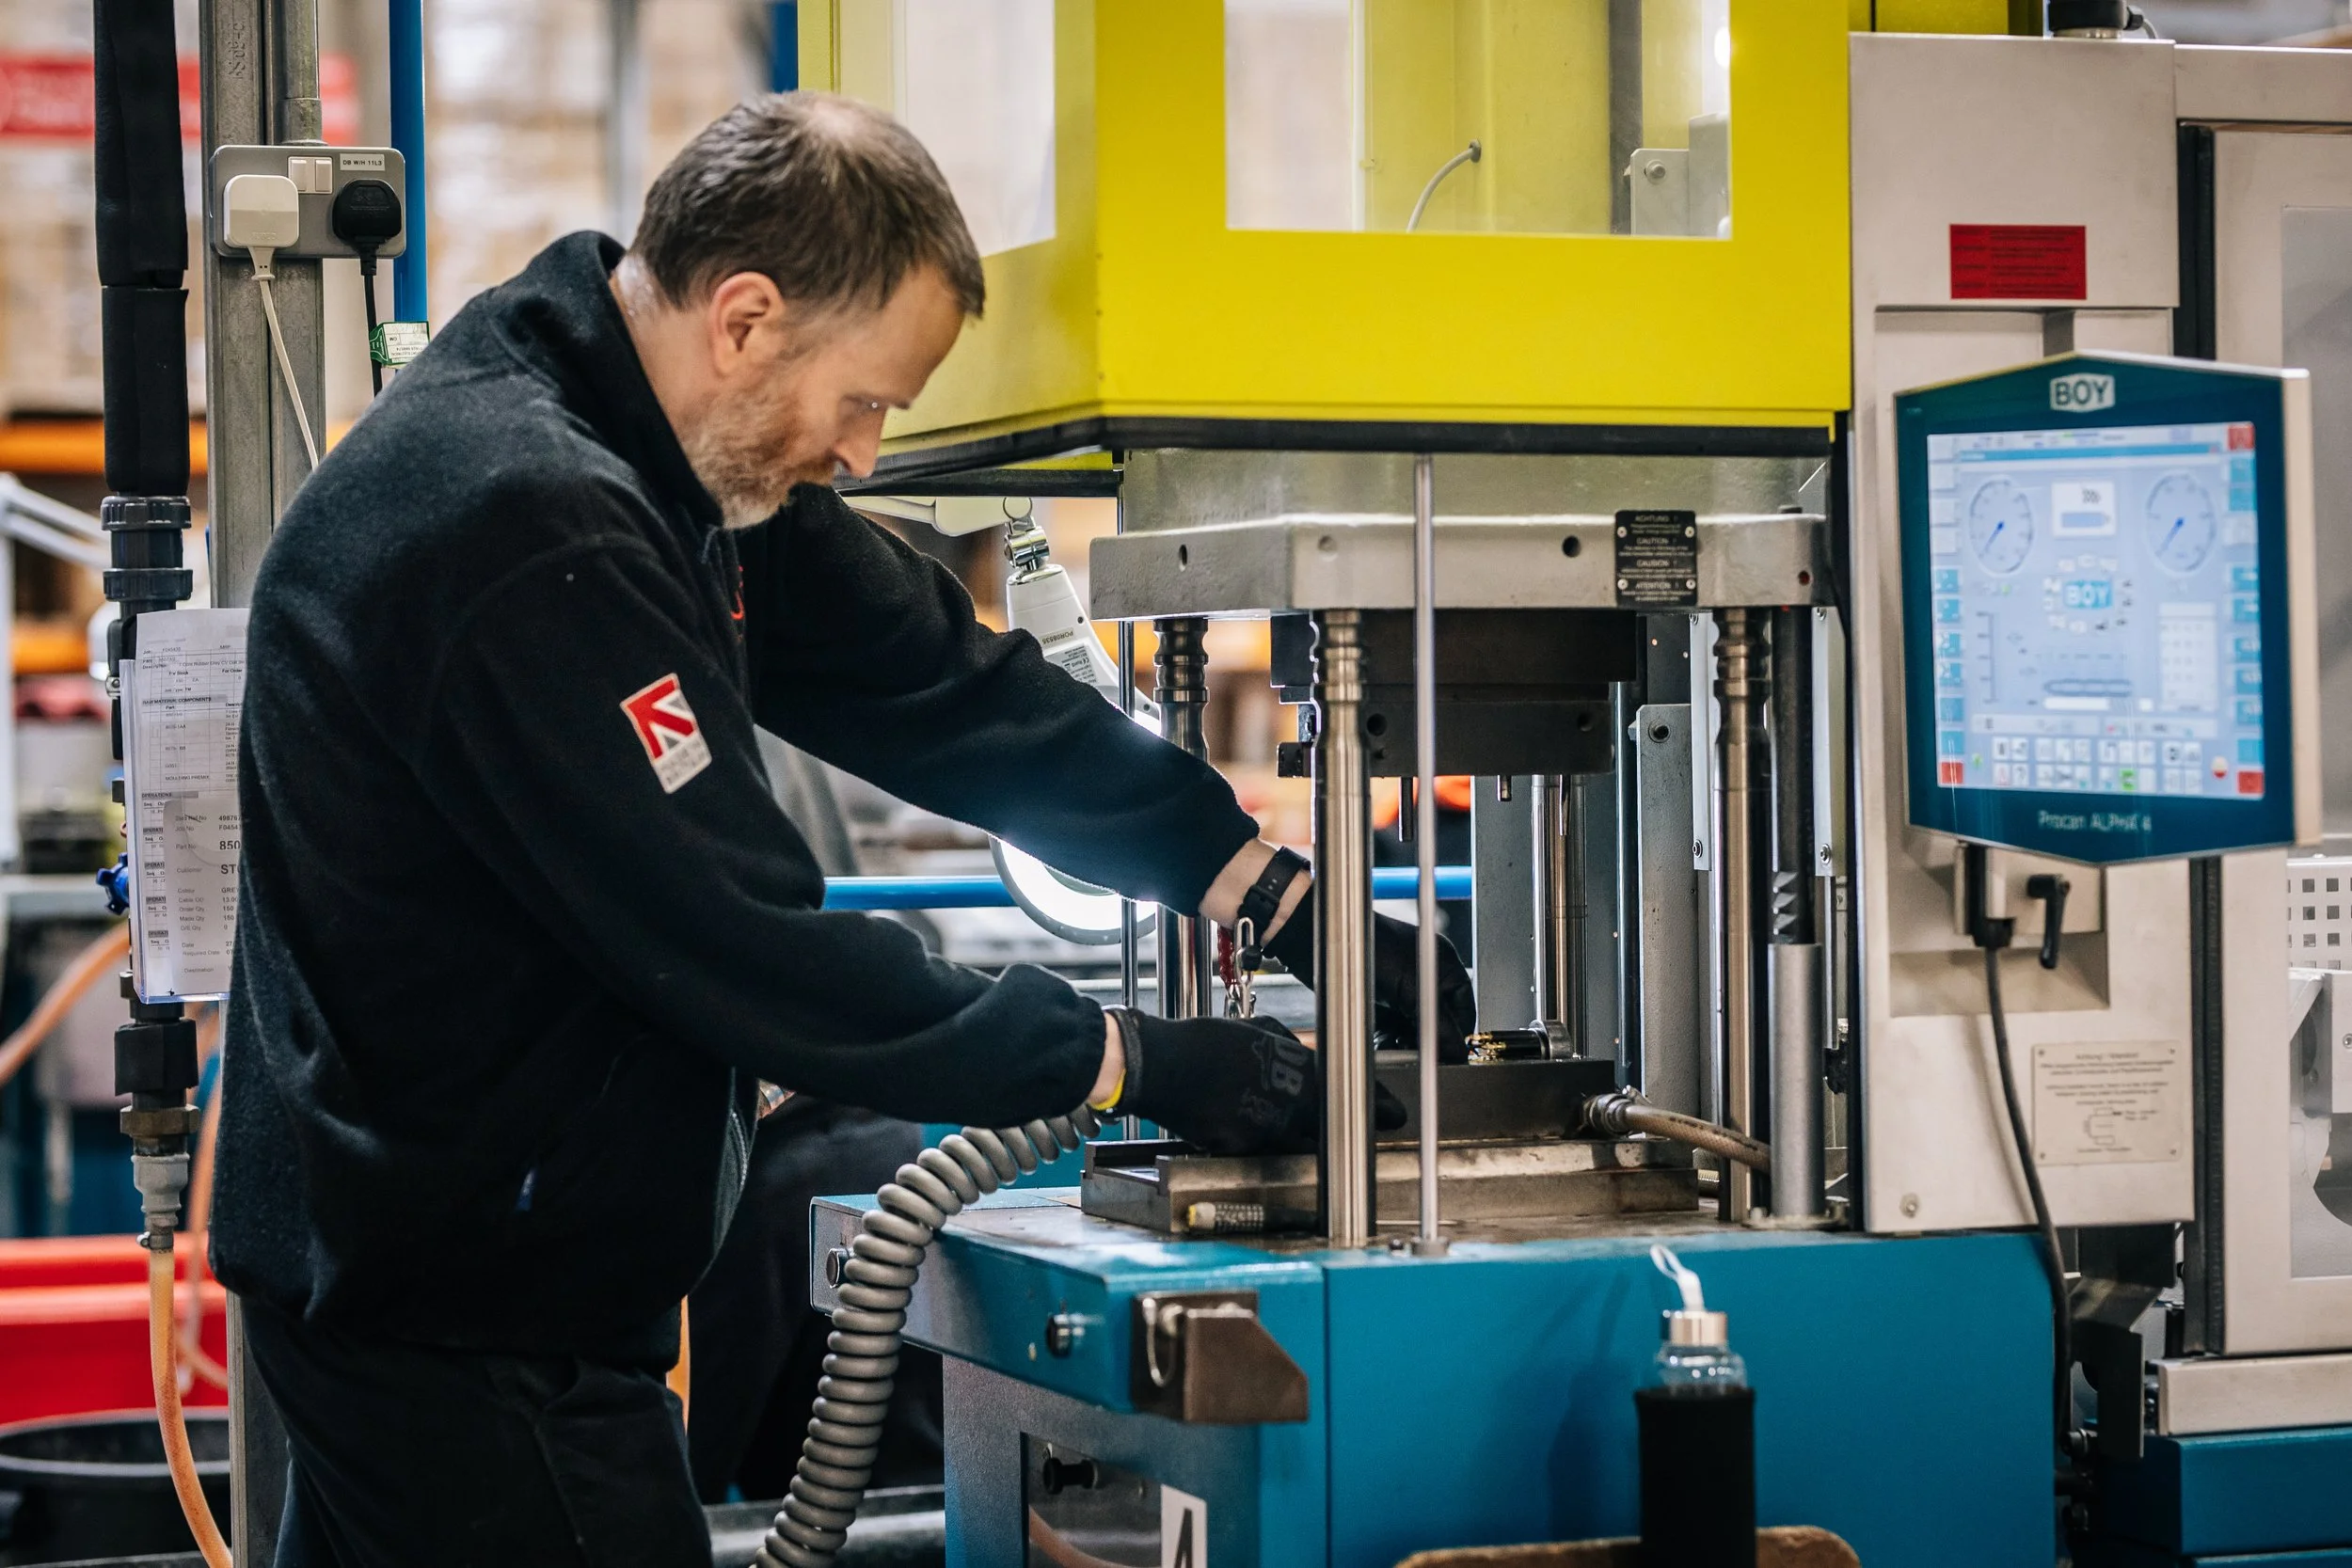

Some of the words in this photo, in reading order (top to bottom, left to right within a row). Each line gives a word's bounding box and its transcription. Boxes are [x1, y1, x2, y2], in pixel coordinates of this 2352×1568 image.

[2055, 379, 2108, 405] BOY
[2066, 583, 2109, 606] BOY
[219, 840, 241, 850] 850
